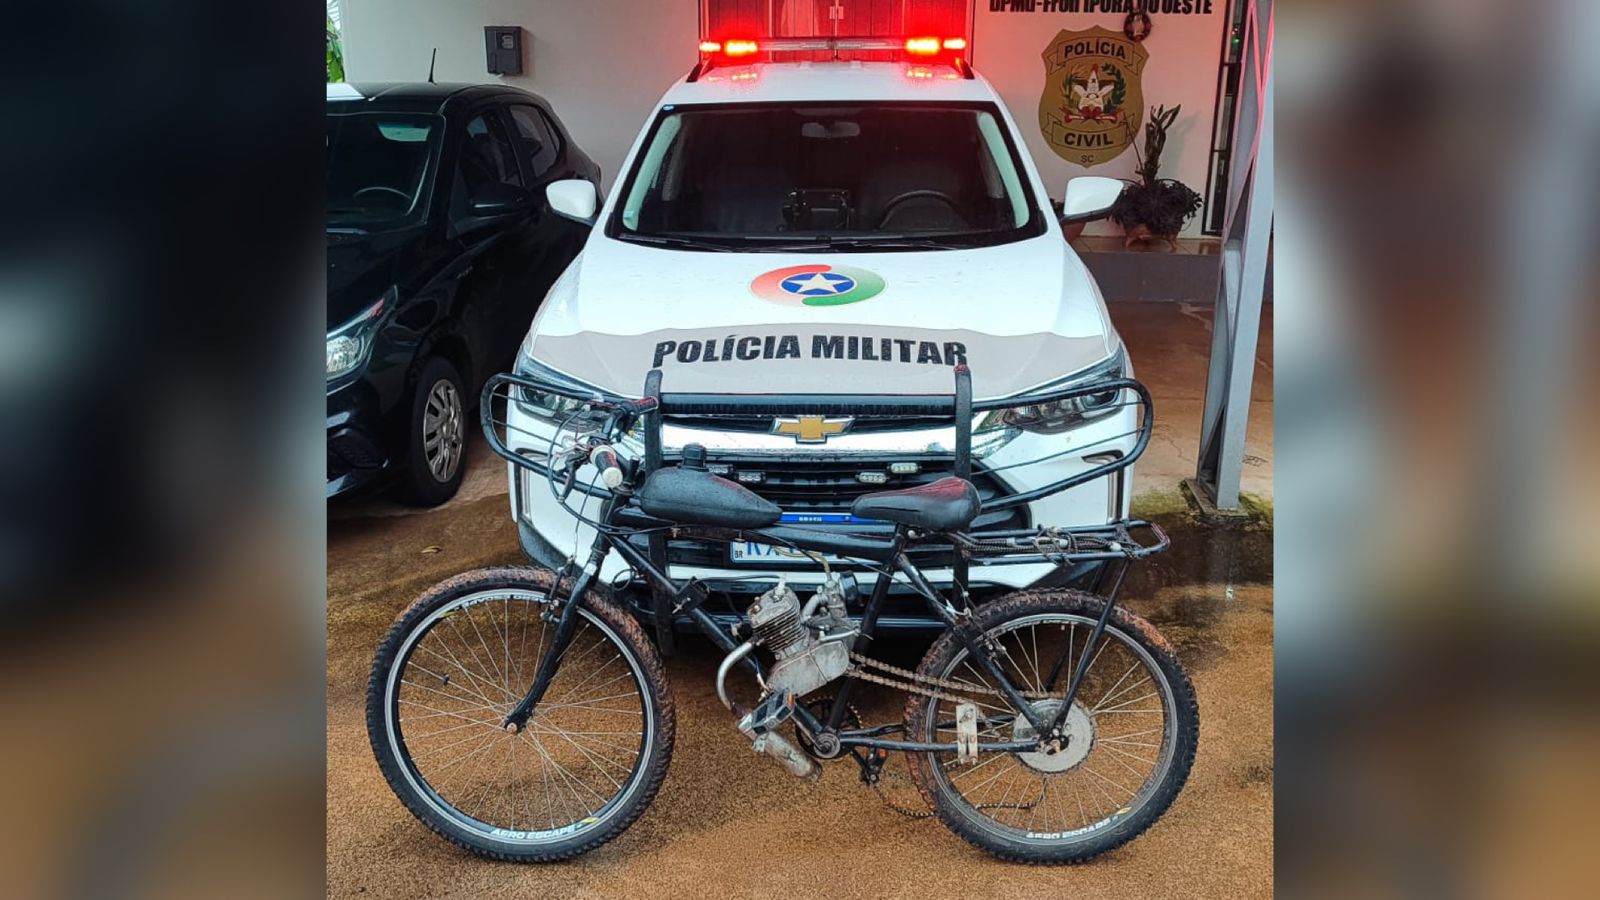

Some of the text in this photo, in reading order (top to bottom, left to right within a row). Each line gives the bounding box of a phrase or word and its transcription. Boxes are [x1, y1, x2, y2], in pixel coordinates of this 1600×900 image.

[1161, 0, 1212, 14] OESTE
[1064, 38, 1126, 59] POLÍCIA
[1064, 132, 1114, 147] CIVIL
[1080, 154, 1095, 163] SC
[652, 334, 967, 368] POLÍCIA MILITAR
[490, 823, 576, 839] AERO ESCAPE
